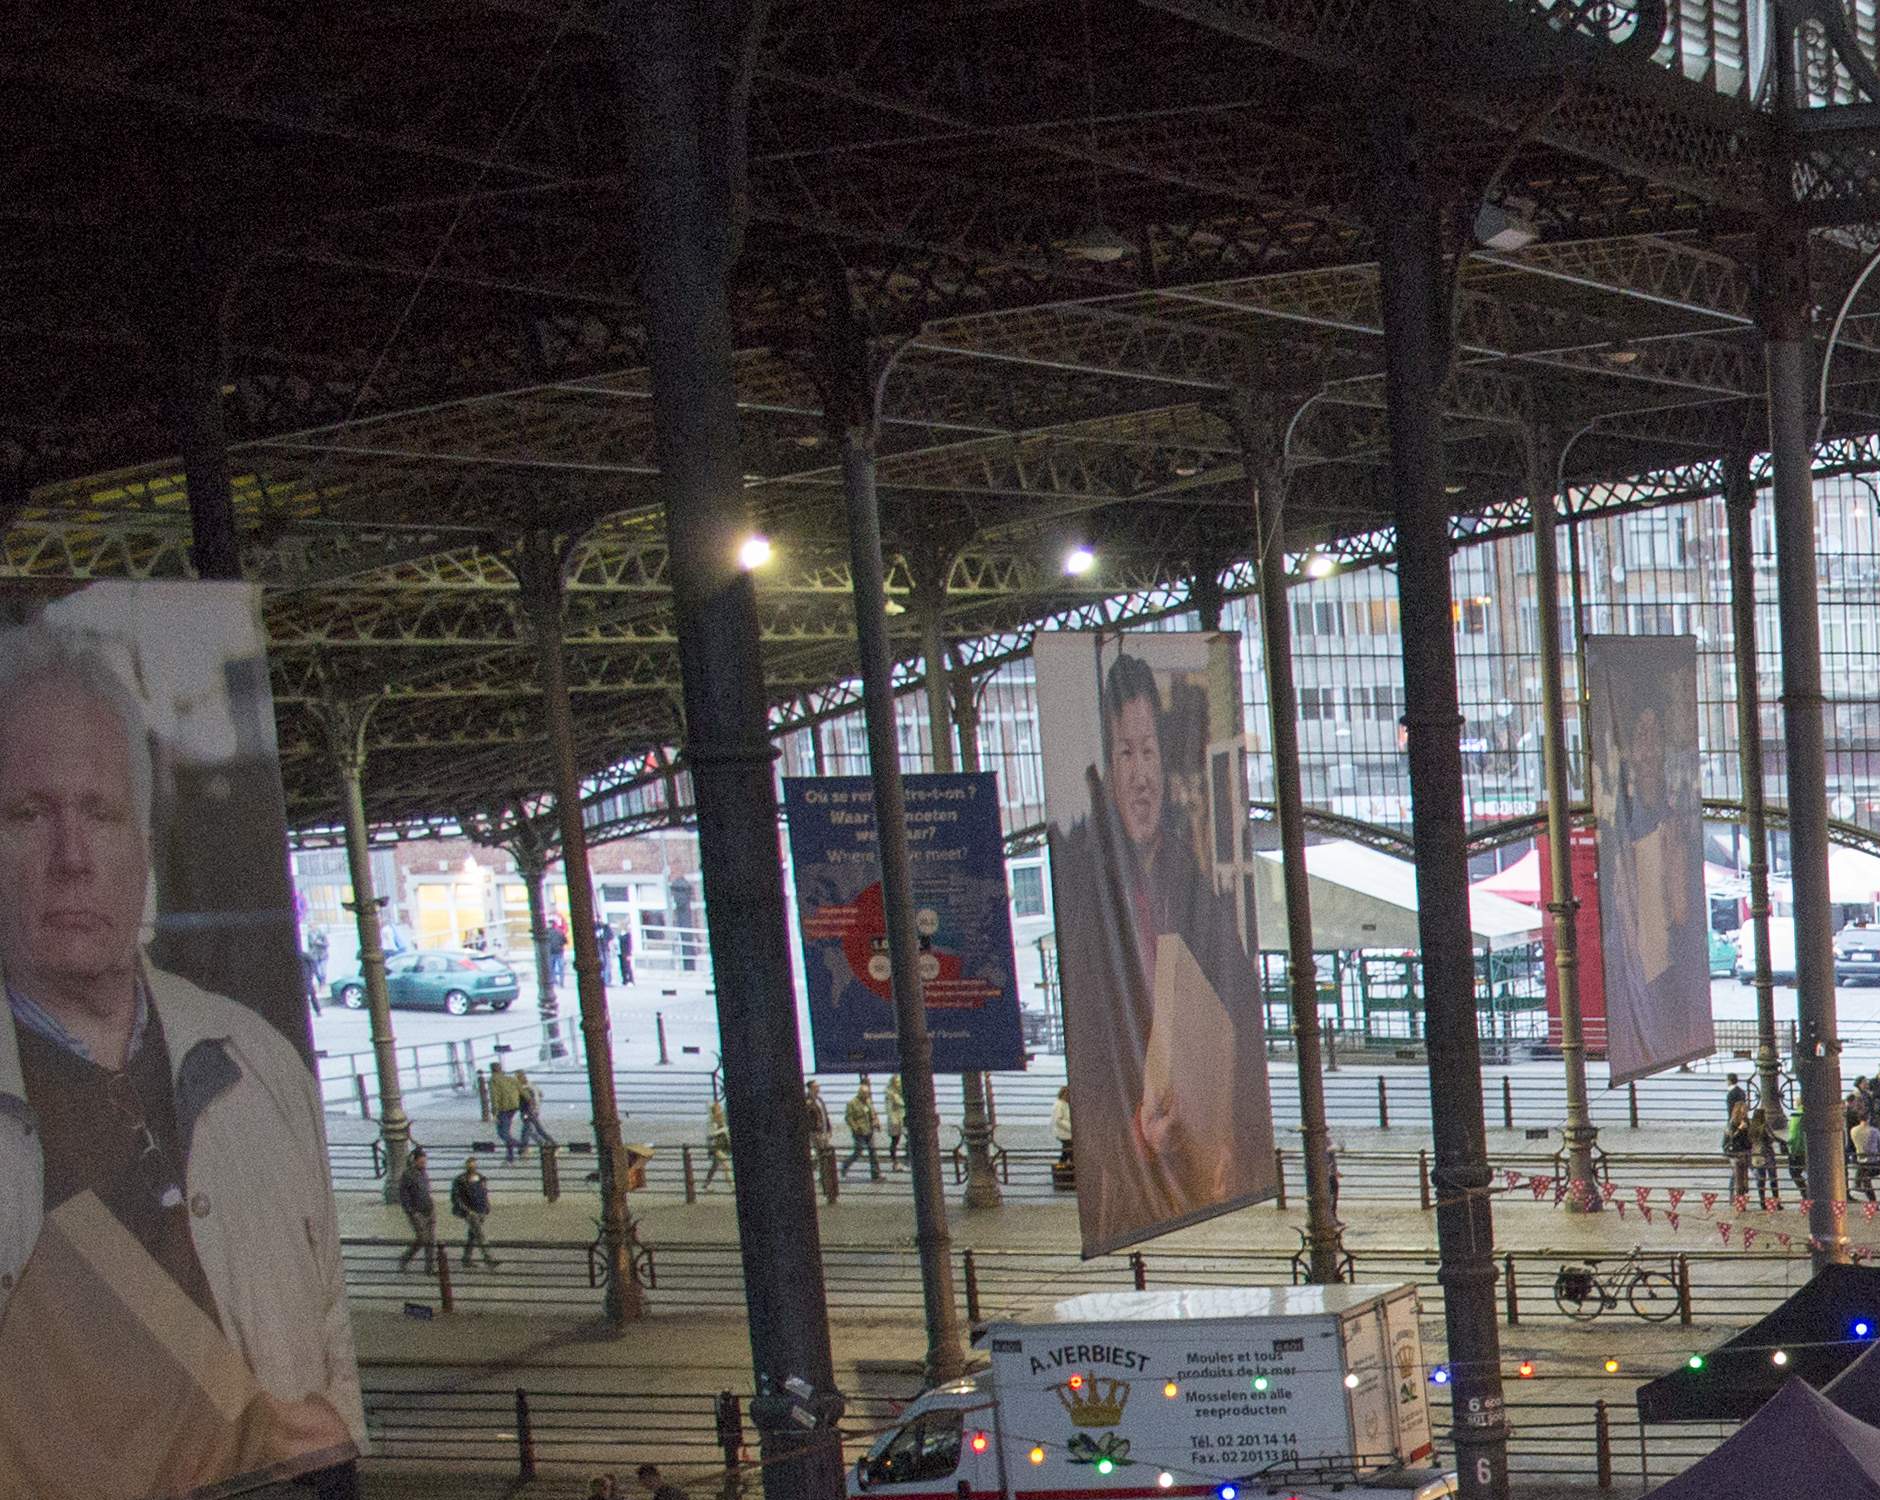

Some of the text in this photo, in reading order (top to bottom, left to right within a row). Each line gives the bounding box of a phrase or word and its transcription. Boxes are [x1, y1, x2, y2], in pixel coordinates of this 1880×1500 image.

[1029, 1344, 1151, 1375] A.VERBIEST
[1186, 1351, 1284, 1365] Moules et tous
[1177, 1364, 1296, 1380] produits de la mer
[1185, 1388, 1293, 1404] Mosselen en alle
[1194, 1403, 1287, 1418] zeeproducten
[1468, 1397, 1481, 1412] 6
[1190, 1433, 1215, 1448] Tél.
[1218, 1434, 1237, 1447] 02
[1191, 1450, 1220, 1464] Fax.
[1221, 1450, 1238, 1464] 02
[1476, 1457, 1492, 1485] 6
